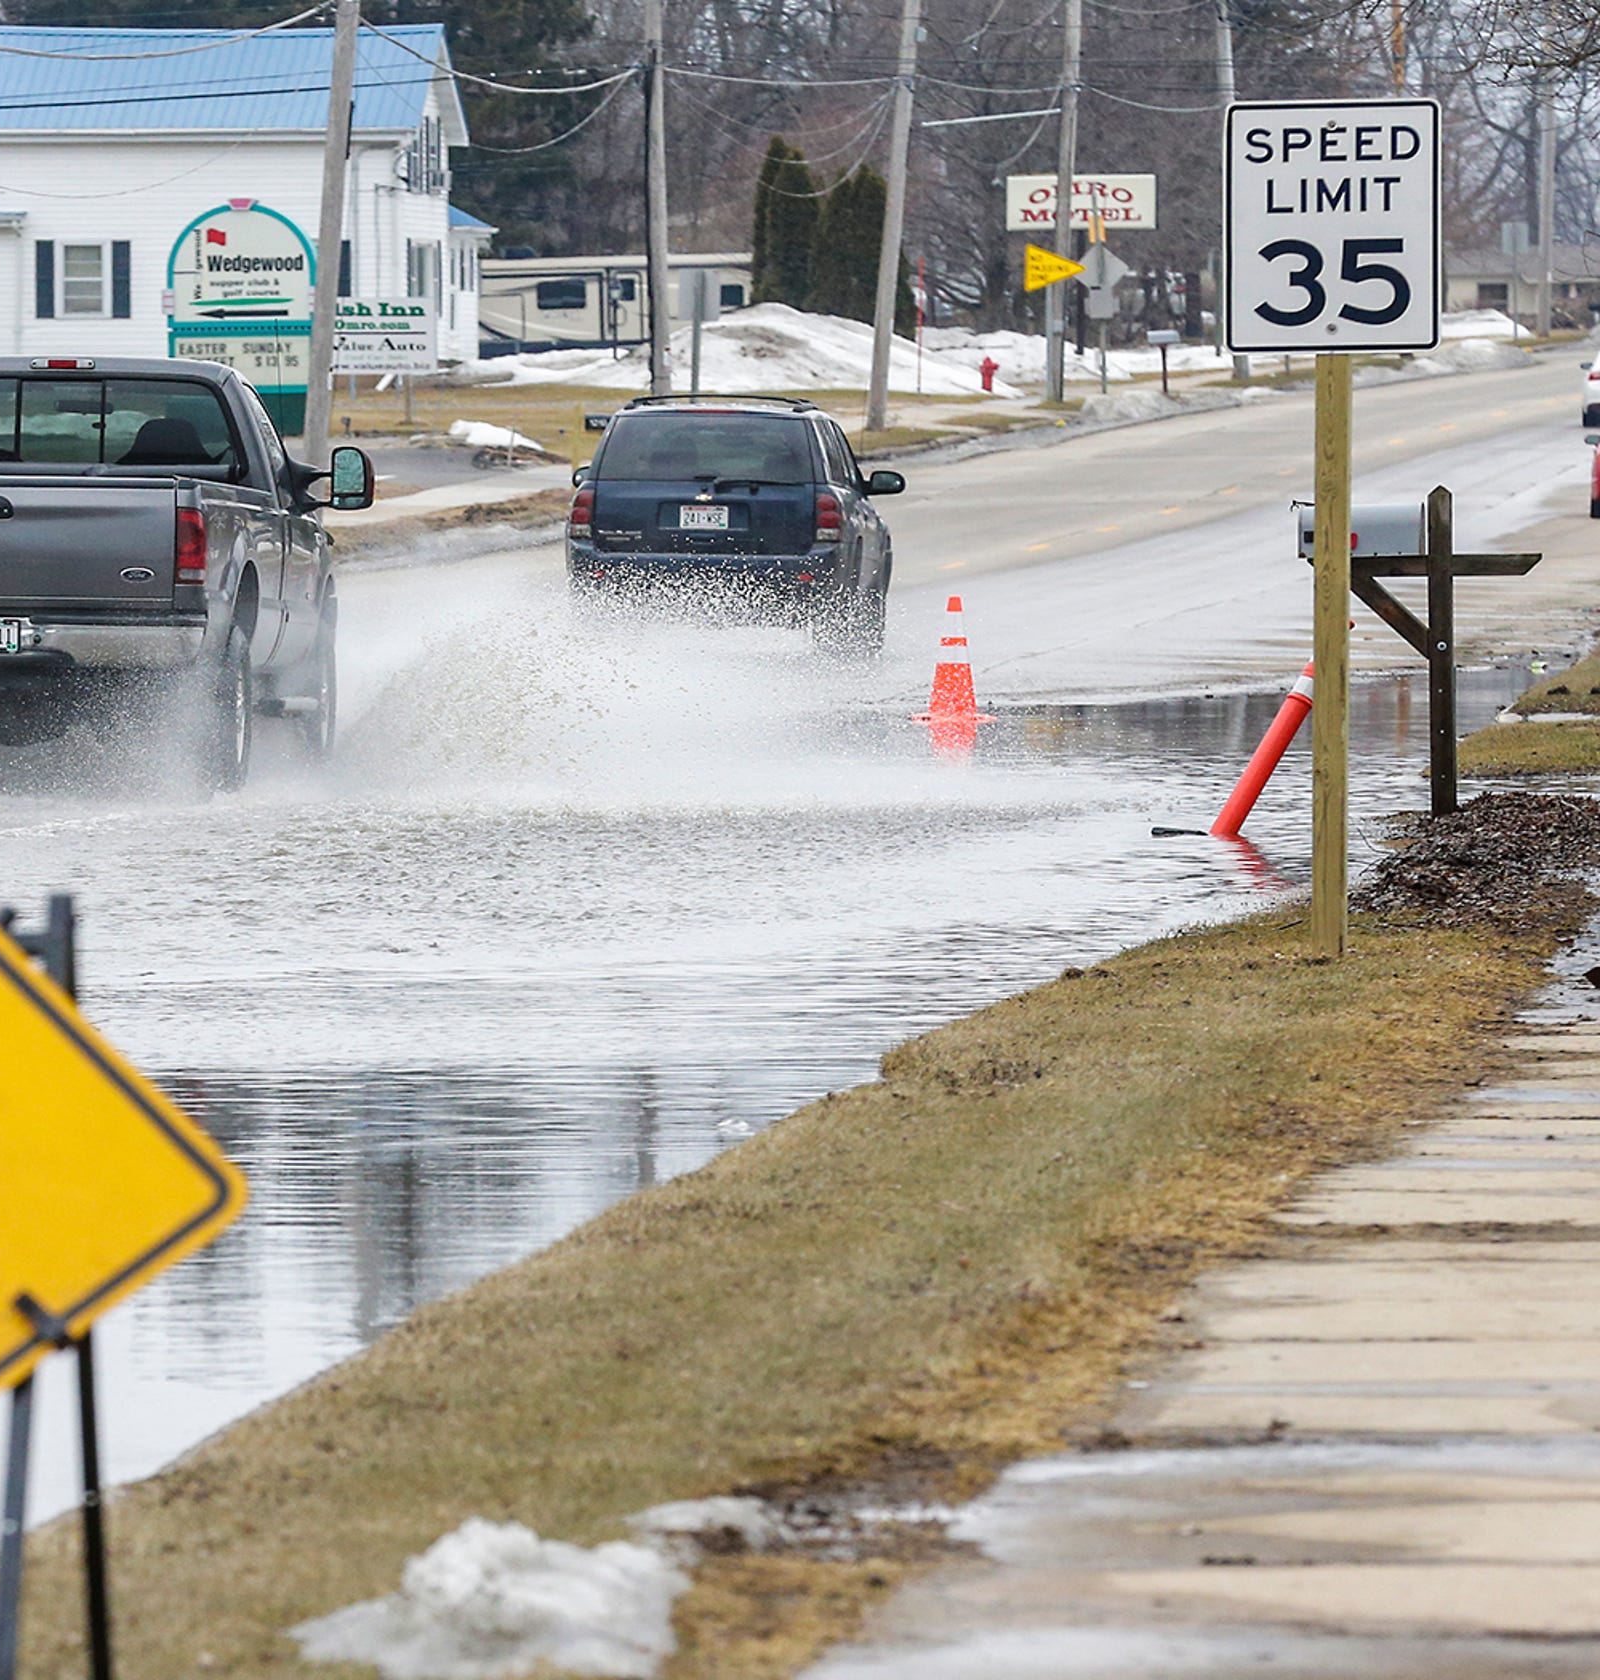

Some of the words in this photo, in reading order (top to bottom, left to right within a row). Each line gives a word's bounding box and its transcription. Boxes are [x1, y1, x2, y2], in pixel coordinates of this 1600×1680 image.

[1245, 126, 1421, 163] SPEED
[1266, 177, 1401, 214] LIMIT
[206, 254, 304, 273] Wedgewood
[1254, 238, 1411, 327] 35
[378, 302, 425, 316] Inn
[179, 343, 228, 355] EASTER
[242, 342, 292, 354] SUNDAY
[377, 337, 427, 351] Auto
